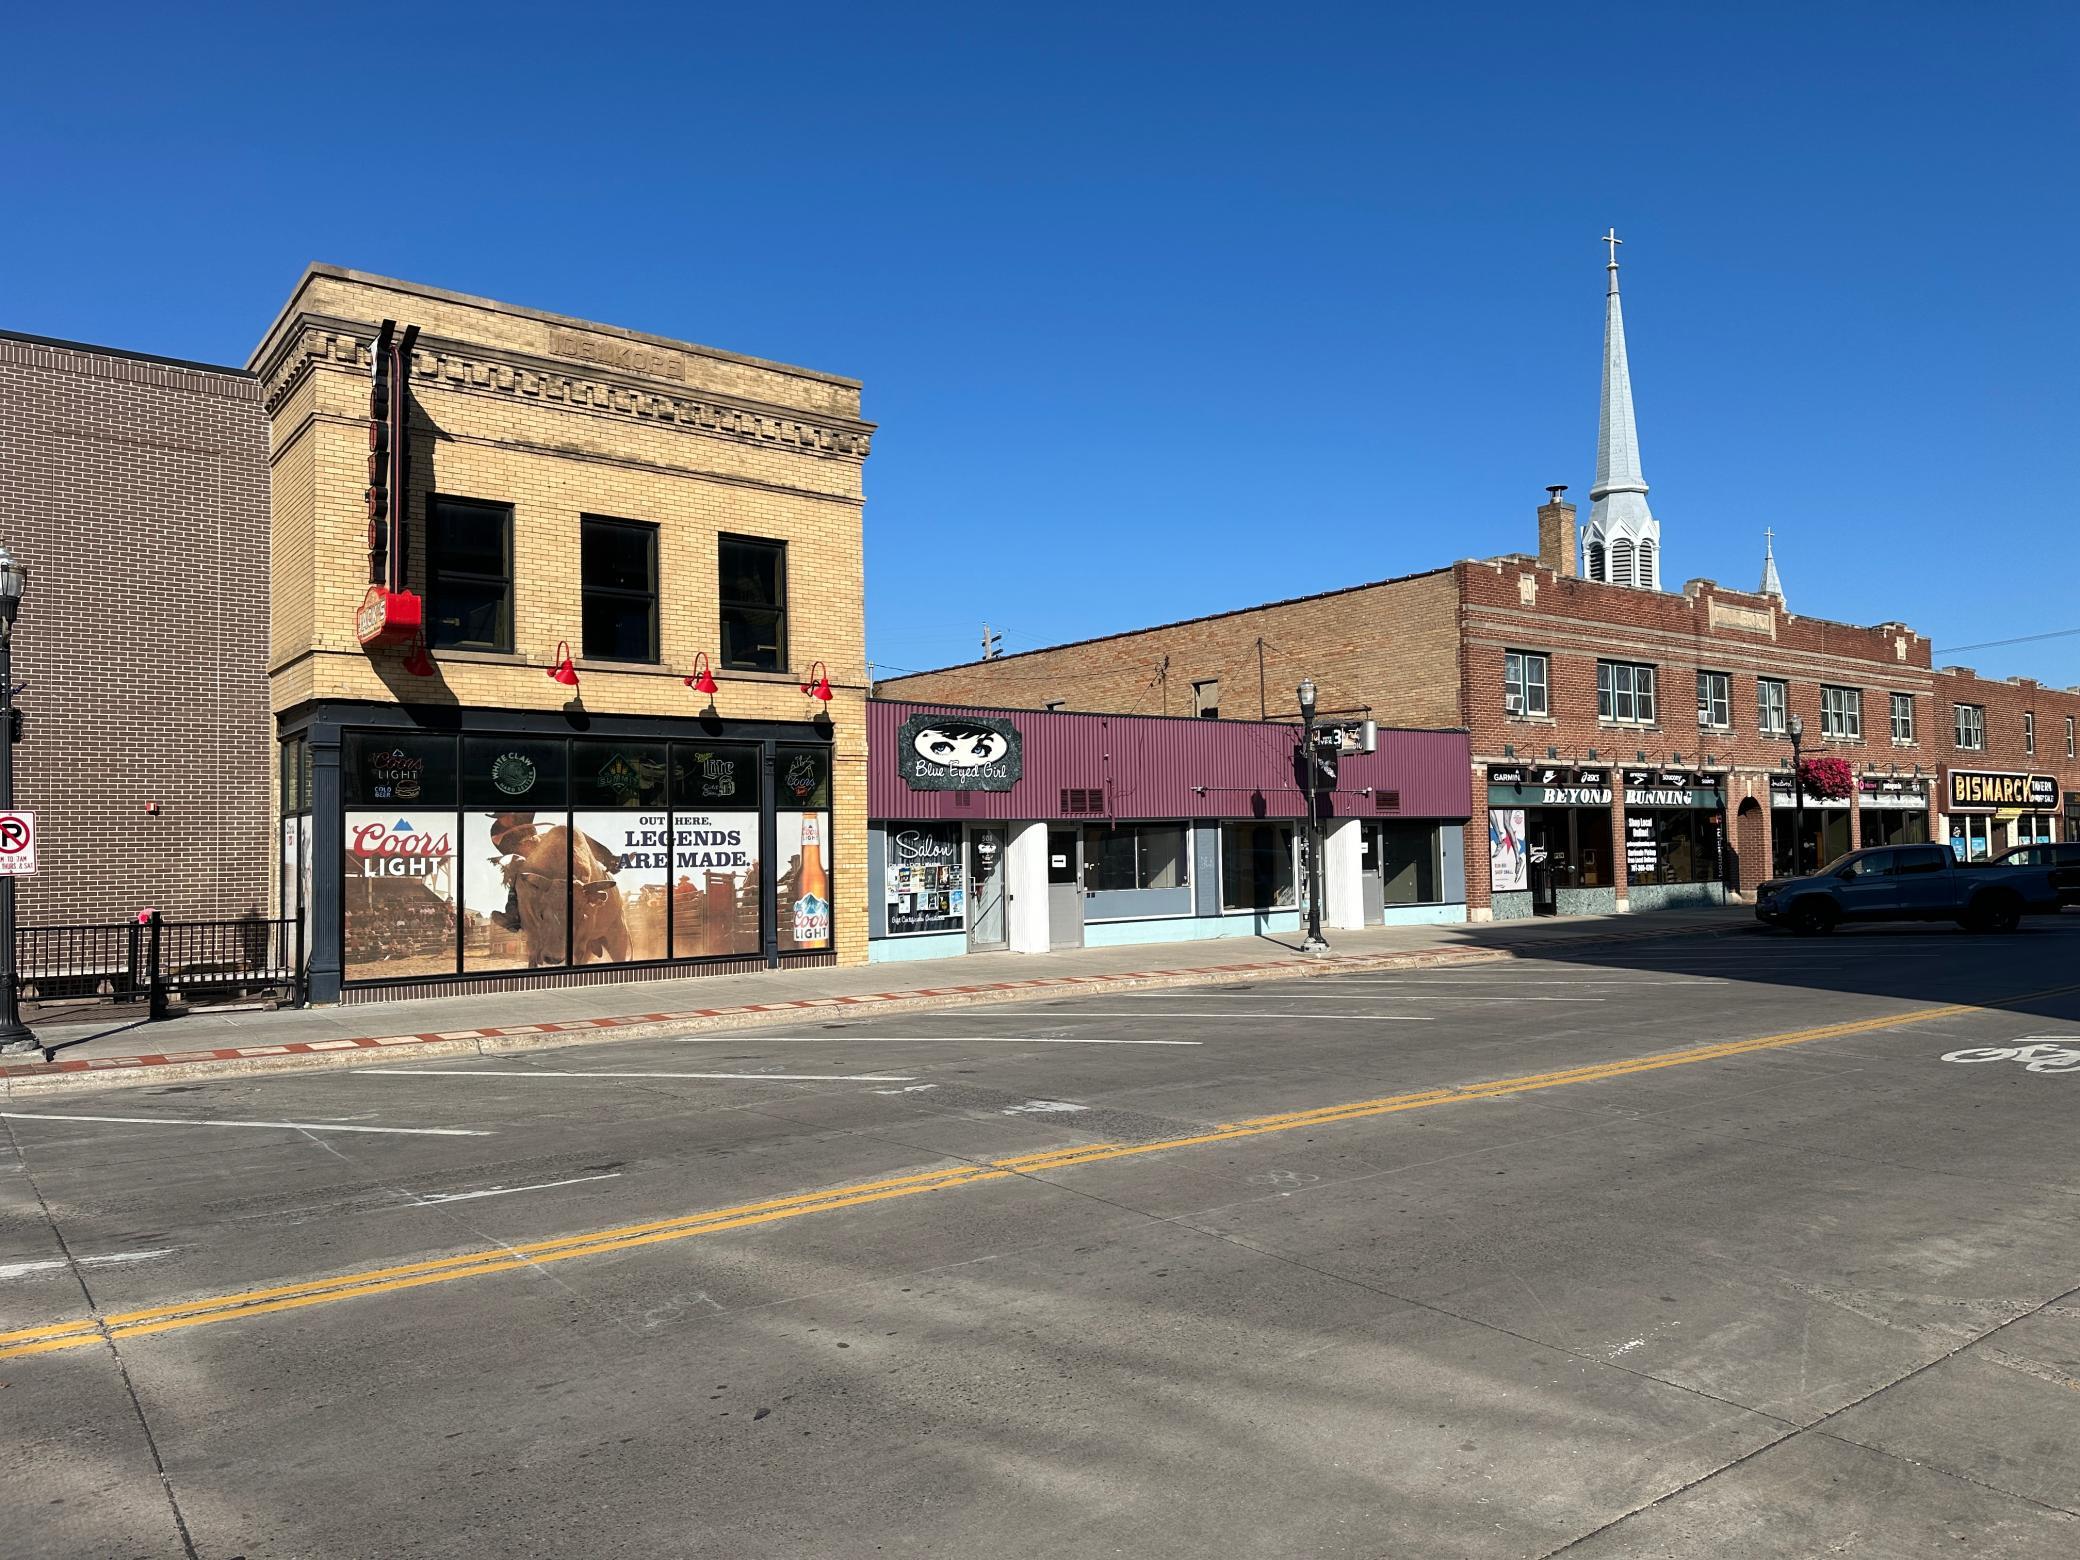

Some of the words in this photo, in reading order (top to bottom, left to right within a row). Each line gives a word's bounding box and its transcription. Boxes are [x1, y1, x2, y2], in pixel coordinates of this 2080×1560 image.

[360, 599, 385, 633] JACK'S
[1333, 729, 1342, 745] 3
[378, 770, 418, 780] LIGHT
[492, 754, 507, 780] WHITE
[508, 752, 533, 766] CLAW
[702, 759, 735, 780] Lite
[915, 760, 945, 777] Blue
[949, 760, 980, 784] Eyed
[983, 761, 1007, 778] Girl
[1493, 772, 1521, 782] GARMIN
[2031, 780, 2053, 792] TAVERN
[1542, 788, 1614, 804] BEYOND
[1624, 789, 1693, 805] RUNNING
[1955, 772, 2033, 803] BISMARCK
[639, 816, 666, 826] OUT
[674, 816, 712, 826] HERE,
[1628, 817, 1641, 828] Shop
[1641, 817, 1653, 828] Local
[352, 823, 452, 857] Coors
[624, 830, 741, 847] LEGENDS
[896, 830, 953, 859] Salon
[364, 857, 442, 878] LIGHT
[618, 852, 669, 869] ARE
[676, 851, 751, 868] MADE.
[794, 909, 829, 928] Coors
[795, 927, 827, 939] LIGHT
